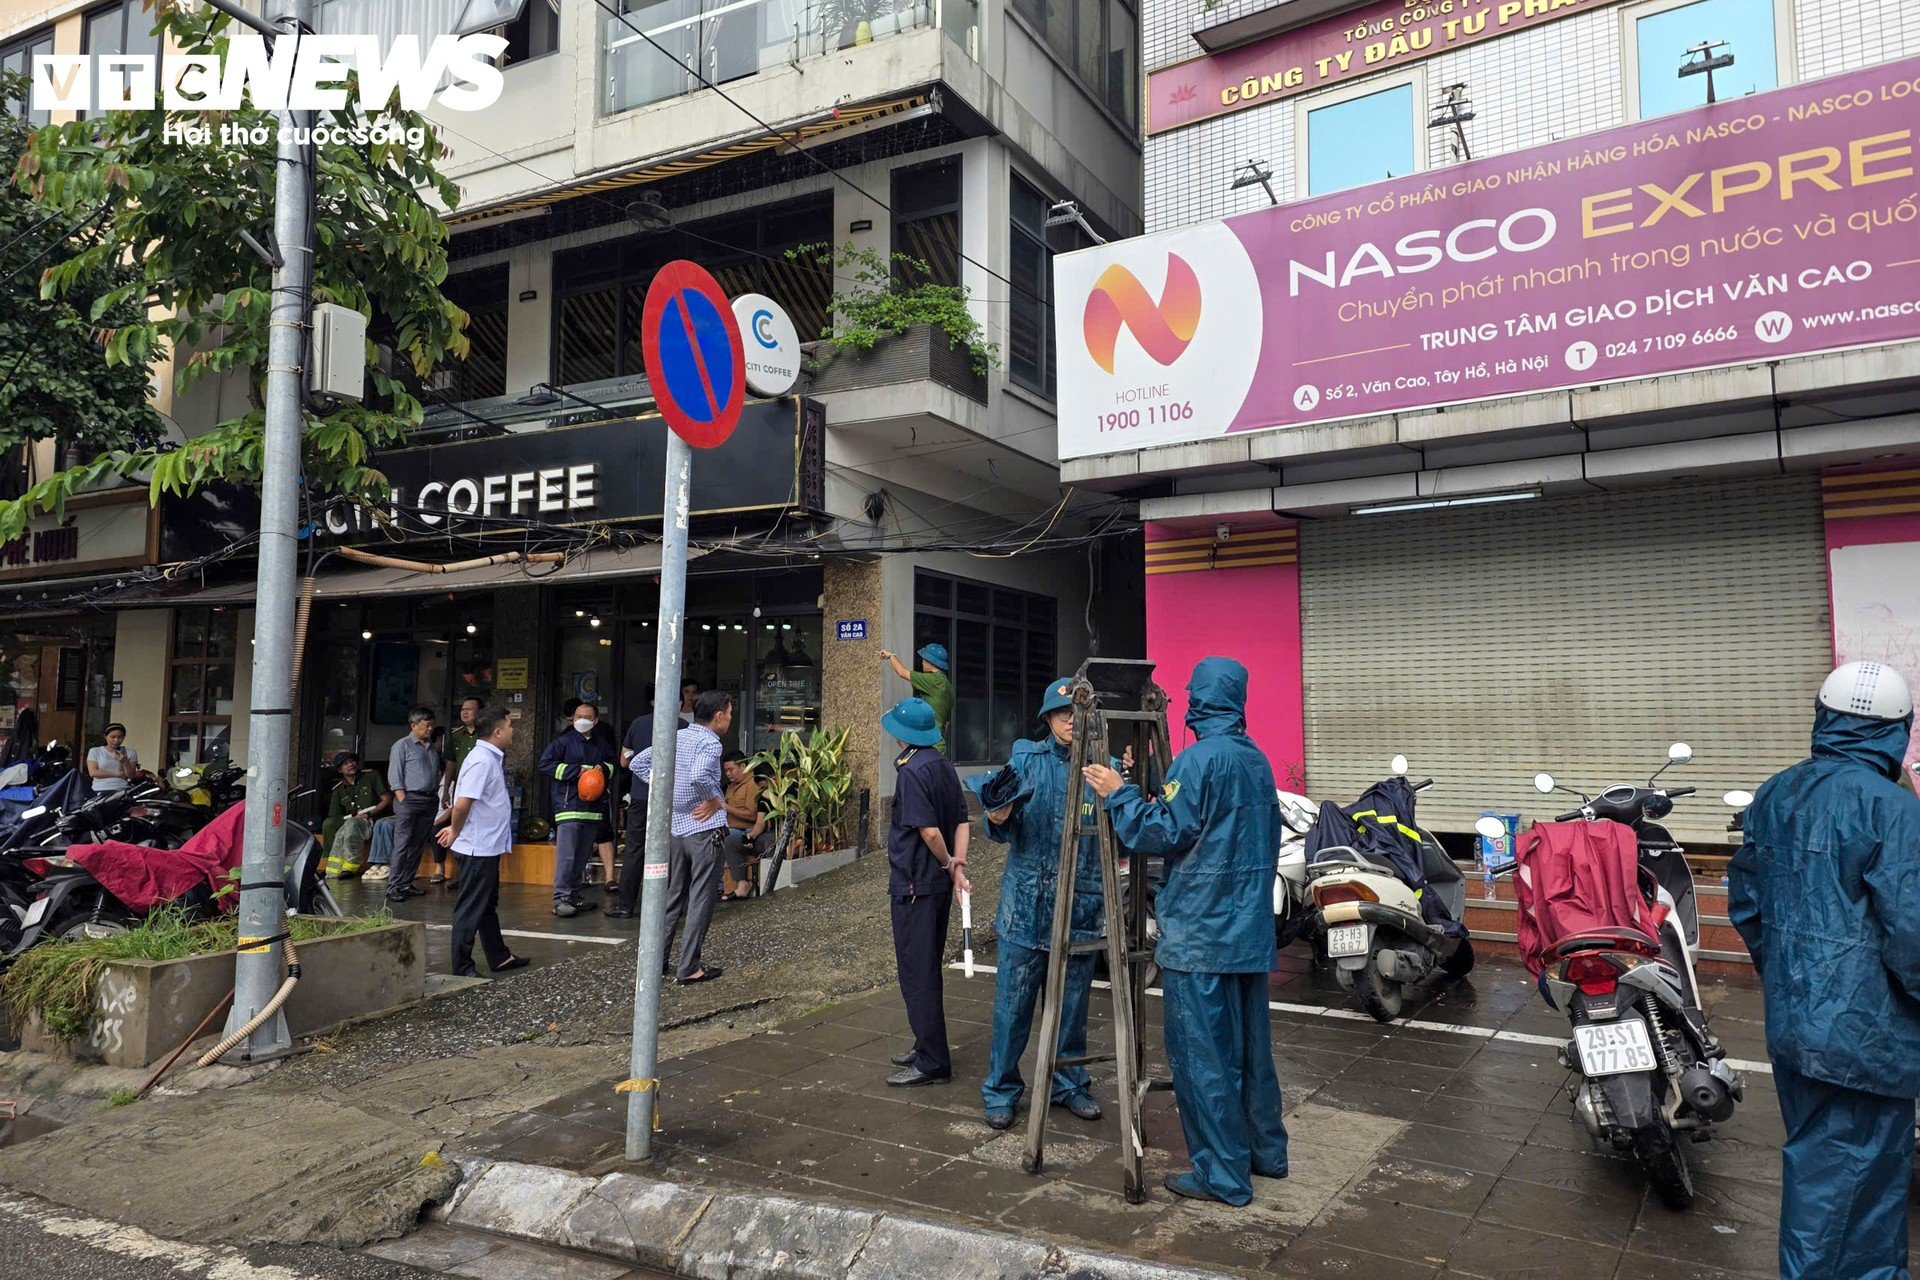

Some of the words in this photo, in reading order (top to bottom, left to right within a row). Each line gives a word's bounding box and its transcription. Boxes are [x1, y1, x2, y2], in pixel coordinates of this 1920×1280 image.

[1344, 20, 1394, 42] TỔNG
[1400, 0, 1453, 26] CÔNG
[1221, 66, 1304, 106] CÔNG
[1315, 49, 1352, 79] TY
[1364, 27, 1432, 65] ĐẦU
[1442, 7, 1490, 41] TƯ
[1290, 208, 1341, 233] CÔNG
[1346, 206, 1363, 220] TY
[1367, 191, 1395, 216] CỔ
[1400, 184, 1447, 209] PHẦN
[1452, 175, 1501, 197] GIAO
[1507, 160, 1561, 186] NHẬN
[1567, 146, 1627, 171] HÀNG
[1633, 132, 1680, 156] HÓA
[1686, 114, 1765, 145] NASCO
[1788, 90, 1873, 122] NASCO
[1289, 207, 1557, 297] NASCO
[1581, 129, 1914, 239] EXPRE
[1338, 286, 1434, 322] Chuyển
[1442, 275, 1503, 308] phát
[1512, 256, 1601, 292] nhanh
[1610, 243, 1690, 274] trong
[1701, 226, 1783, 258] nước
[1794, 213, 1836, 240] và
[1420, 323, 1498, 351] TRUNG
[1504, 313, 1557, 337] TÂM
[1565, 300, 1637, 327] GIAO
[1645, 286, 1714, 316] DỊCH
[1723, 273, 1788, 300] VĂN
[1797, 260, 1873, 290] CAO
[746, 362, 761, 372] CITI
[763, 365, 792, 377] COFFEE
[1325, 384, 1343, 401] Số
[1346, 384, 1359, 398] 2,
[1362, 380, 1390, 395] Văn
[1395, 374, 1431, 389] Cao,
[1434, 368, 1460, 385] Tây
[1465, 361, 1490, 379] Hồ,
[1495, 359, 1517, 375] Hà
[1521, 355, 1549, 371] Nội
[1605, 340, 1637, 358] 024
[1643, 332, 1686, 352] 7109
[1692, 325, 1738, 345] 6666
[1098, 409, 1140, 433] 1900
[1148, 400, 1194, 425] 1106
[1115, 383, 1170, 405] HOTLINE
[418, 463, 598, 525] COFFEE
[841, 622, 851, 631] SỐ
[852, 623, 863, 631] 2A
[767, 680, 787, 688] OPEN
[788, 680, 806, 688] TIME
[1587, 1045, 1650, 1072] 177.85
